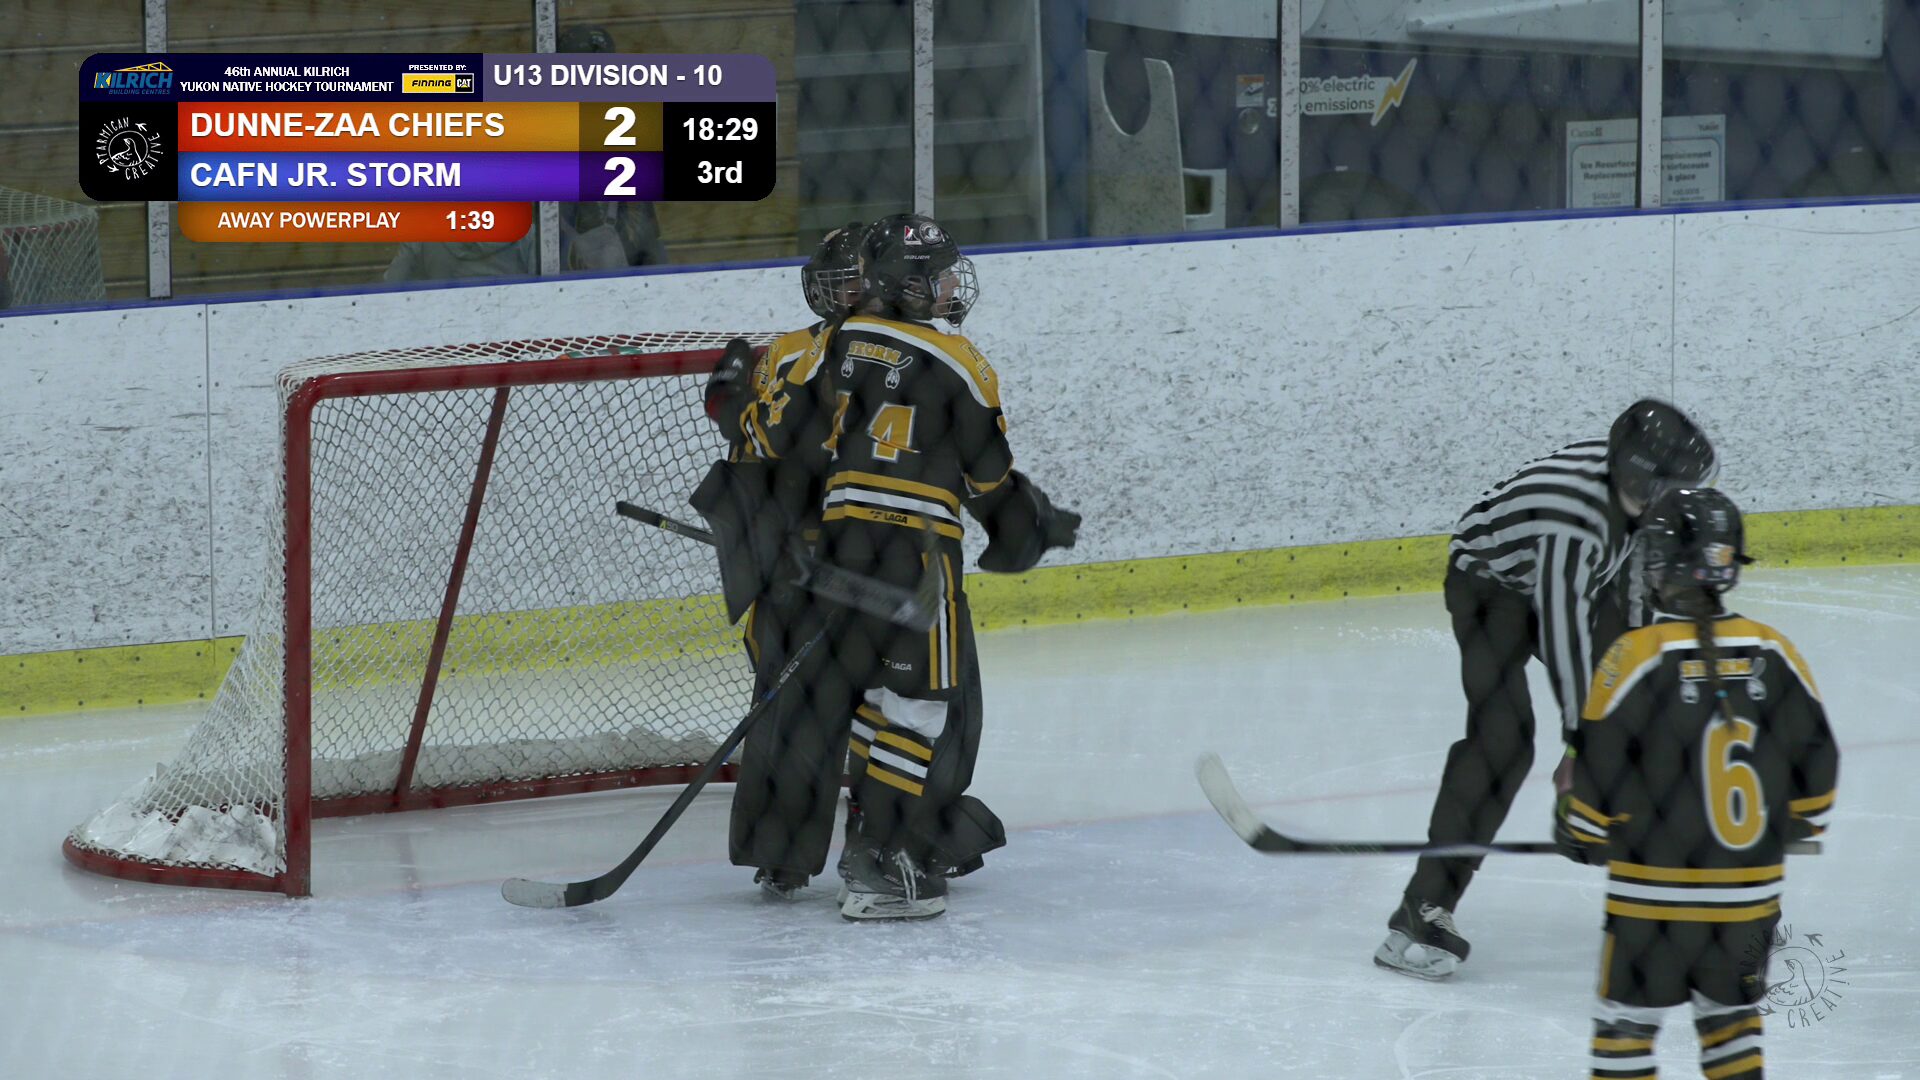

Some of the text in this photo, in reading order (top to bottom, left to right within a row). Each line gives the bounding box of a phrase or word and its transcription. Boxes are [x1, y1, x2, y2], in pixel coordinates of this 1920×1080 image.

[1323, 77, 1376, 93] electric
[1305, 98, 1376, 113] emissions
[848, 340, 902, 365] STORM
[884, 512, 908, 525] LAGA
[891, 660, 913, 672] LAGA
[1702, 713, 1768, 851] 6
